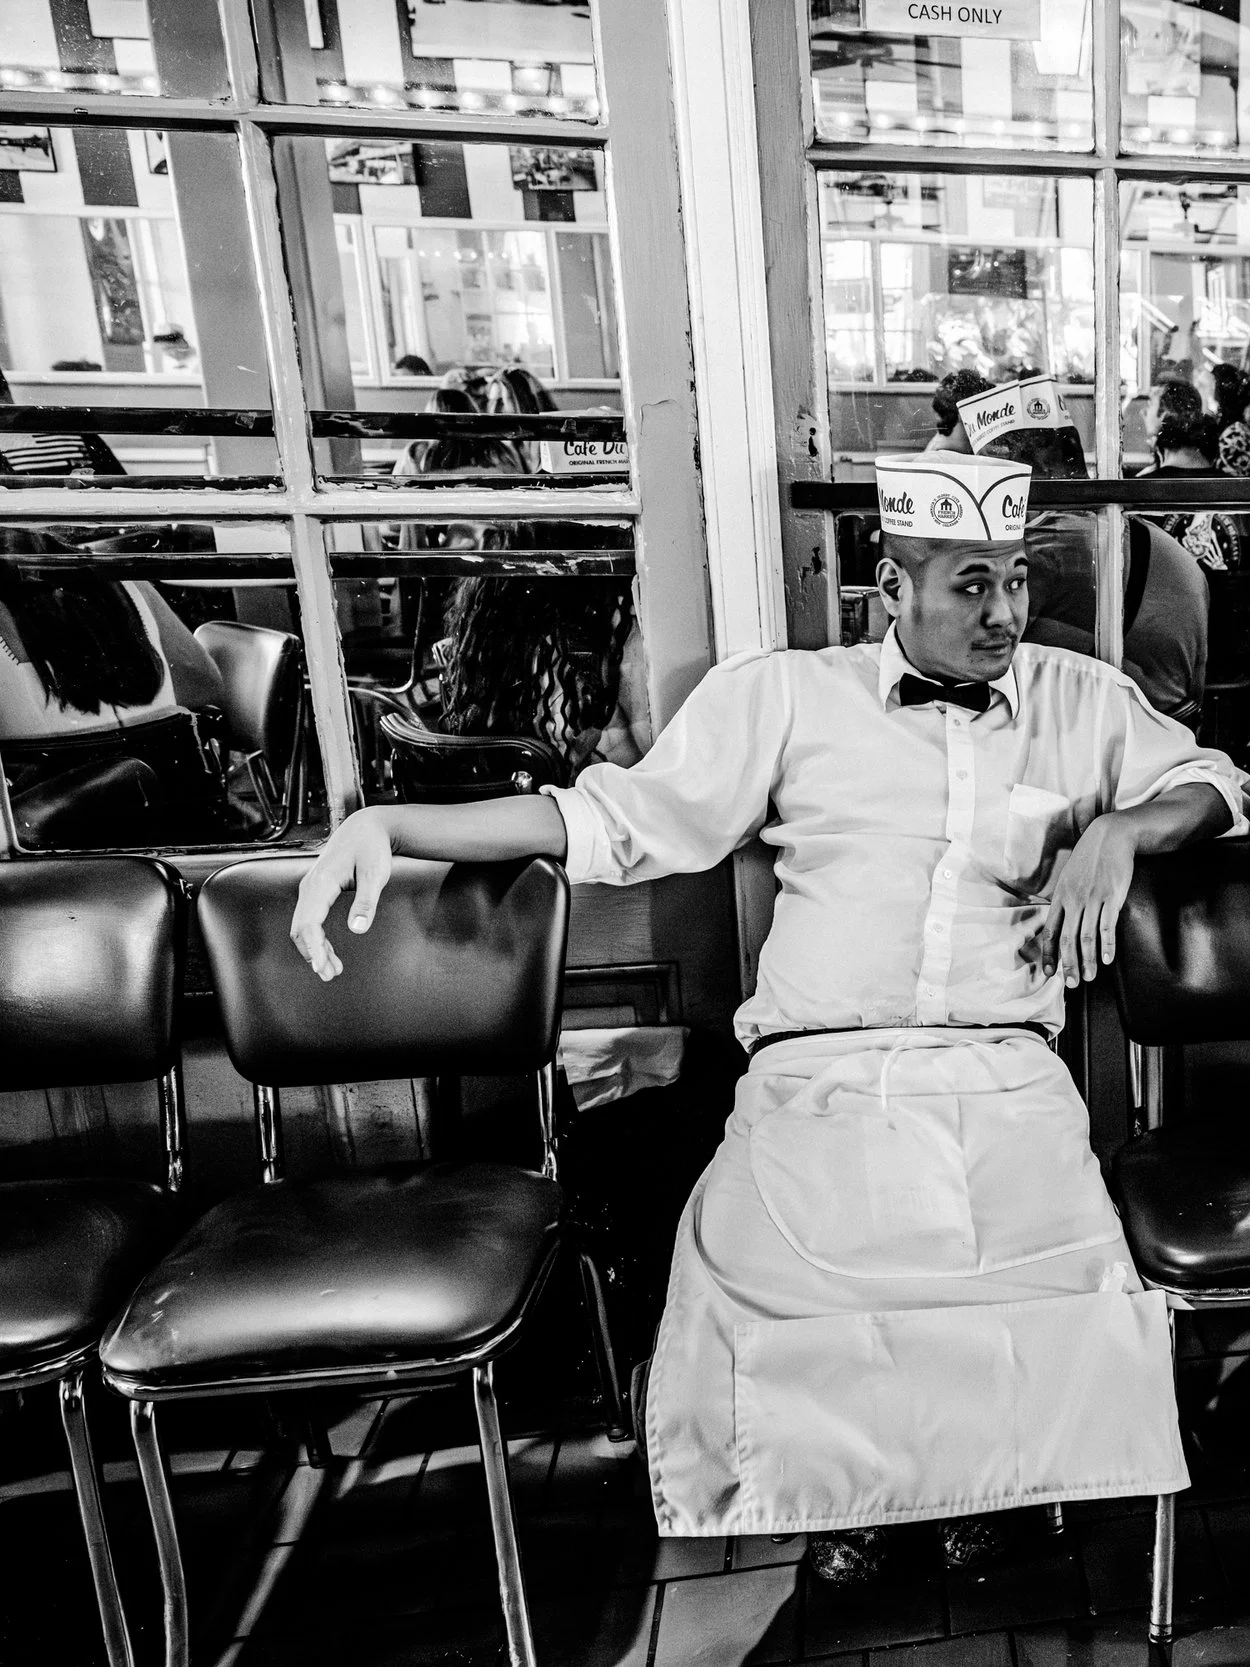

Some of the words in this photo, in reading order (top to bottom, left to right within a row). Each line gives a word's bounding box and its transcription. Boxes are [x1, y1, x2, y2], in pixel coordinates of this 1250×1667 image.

[908, 3, 952, 21] CASH
[958, 6, 1003, 24] ONLY
[976, 402, 1017, 430] Monde
[602, 441, 625, 455] Du
[896, 519, 914, 528] STAND
